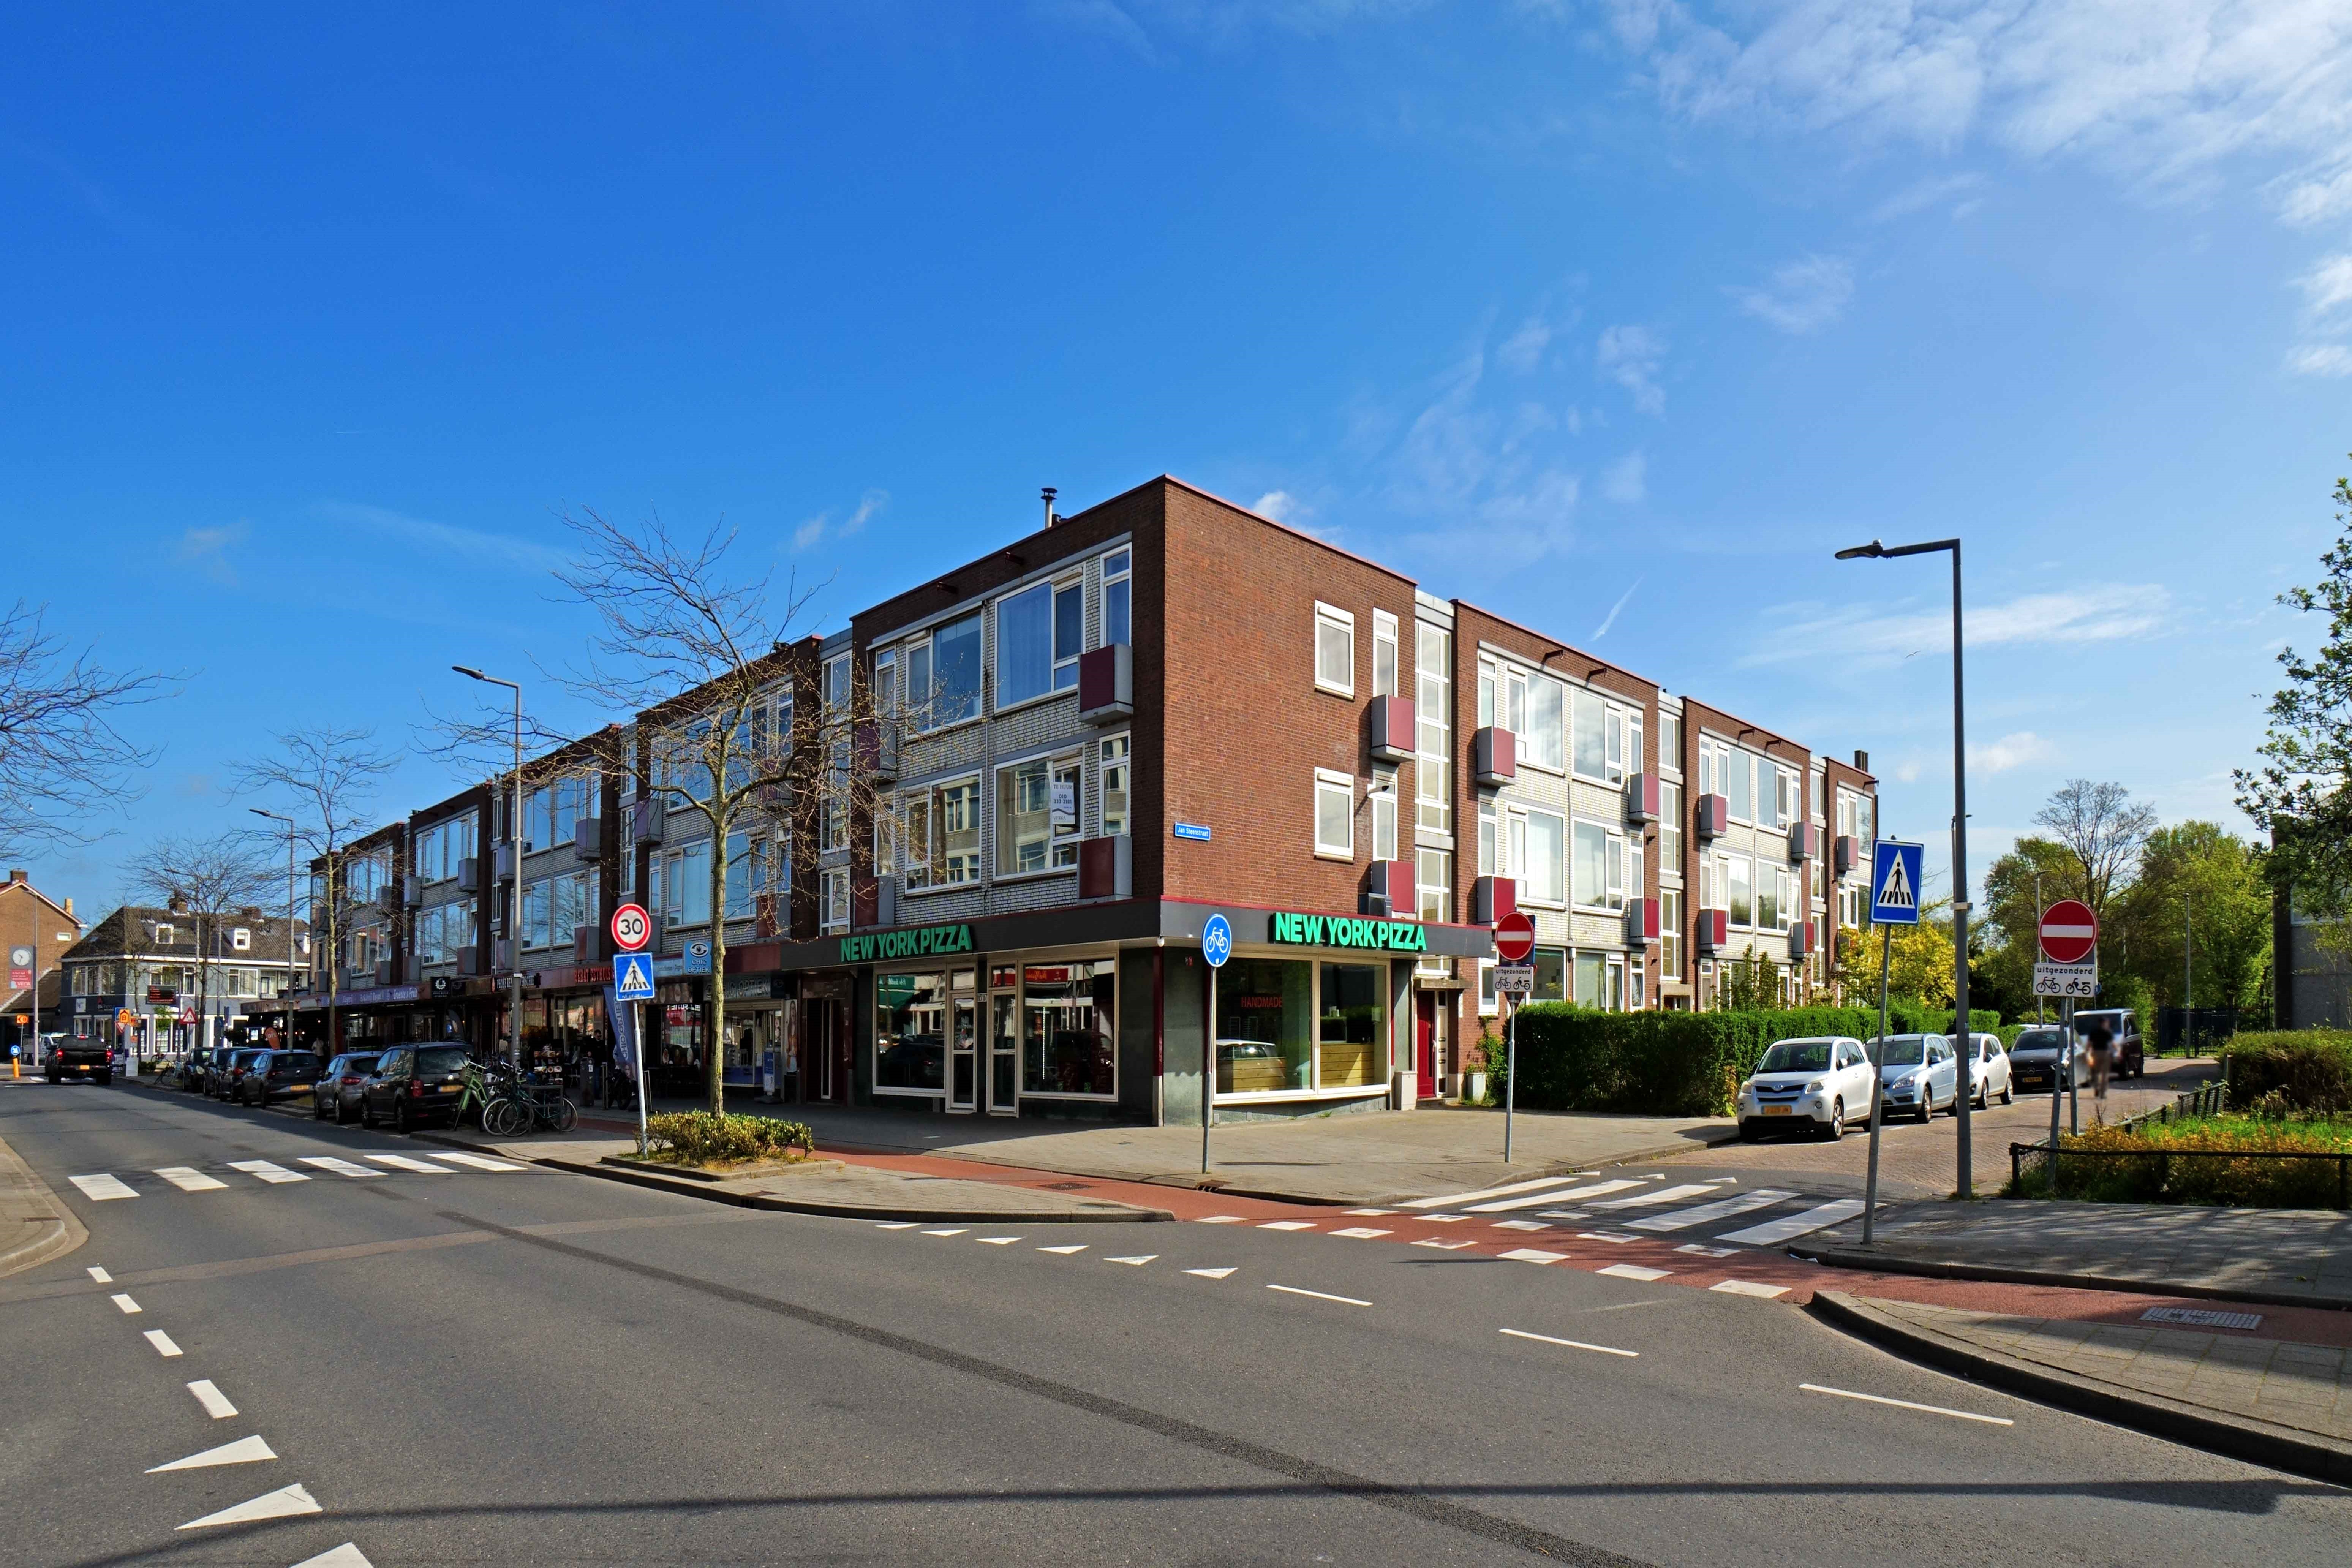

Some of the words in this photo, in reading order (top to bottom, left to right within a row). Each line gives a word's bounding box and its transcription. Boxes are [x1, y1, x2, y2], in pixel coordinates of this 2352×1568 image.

[1186, 827, 1209, 837] Steenstraat
[620, 918, 643, 935] 30
[1275, 912, 1323, 944] NEW
[1326, 917, 1377, 948] YORK
[1377, 921, 1427, 951] PIZZA
[841, 935, 874, 962] NEW
[877, 929, 919, 958] YORK
[920, 924, 973, 954] PIZZA
[2037, 966, 2093, 975] uitgezonderd
[1241, 996, 1282, 1007] HANDMADE
